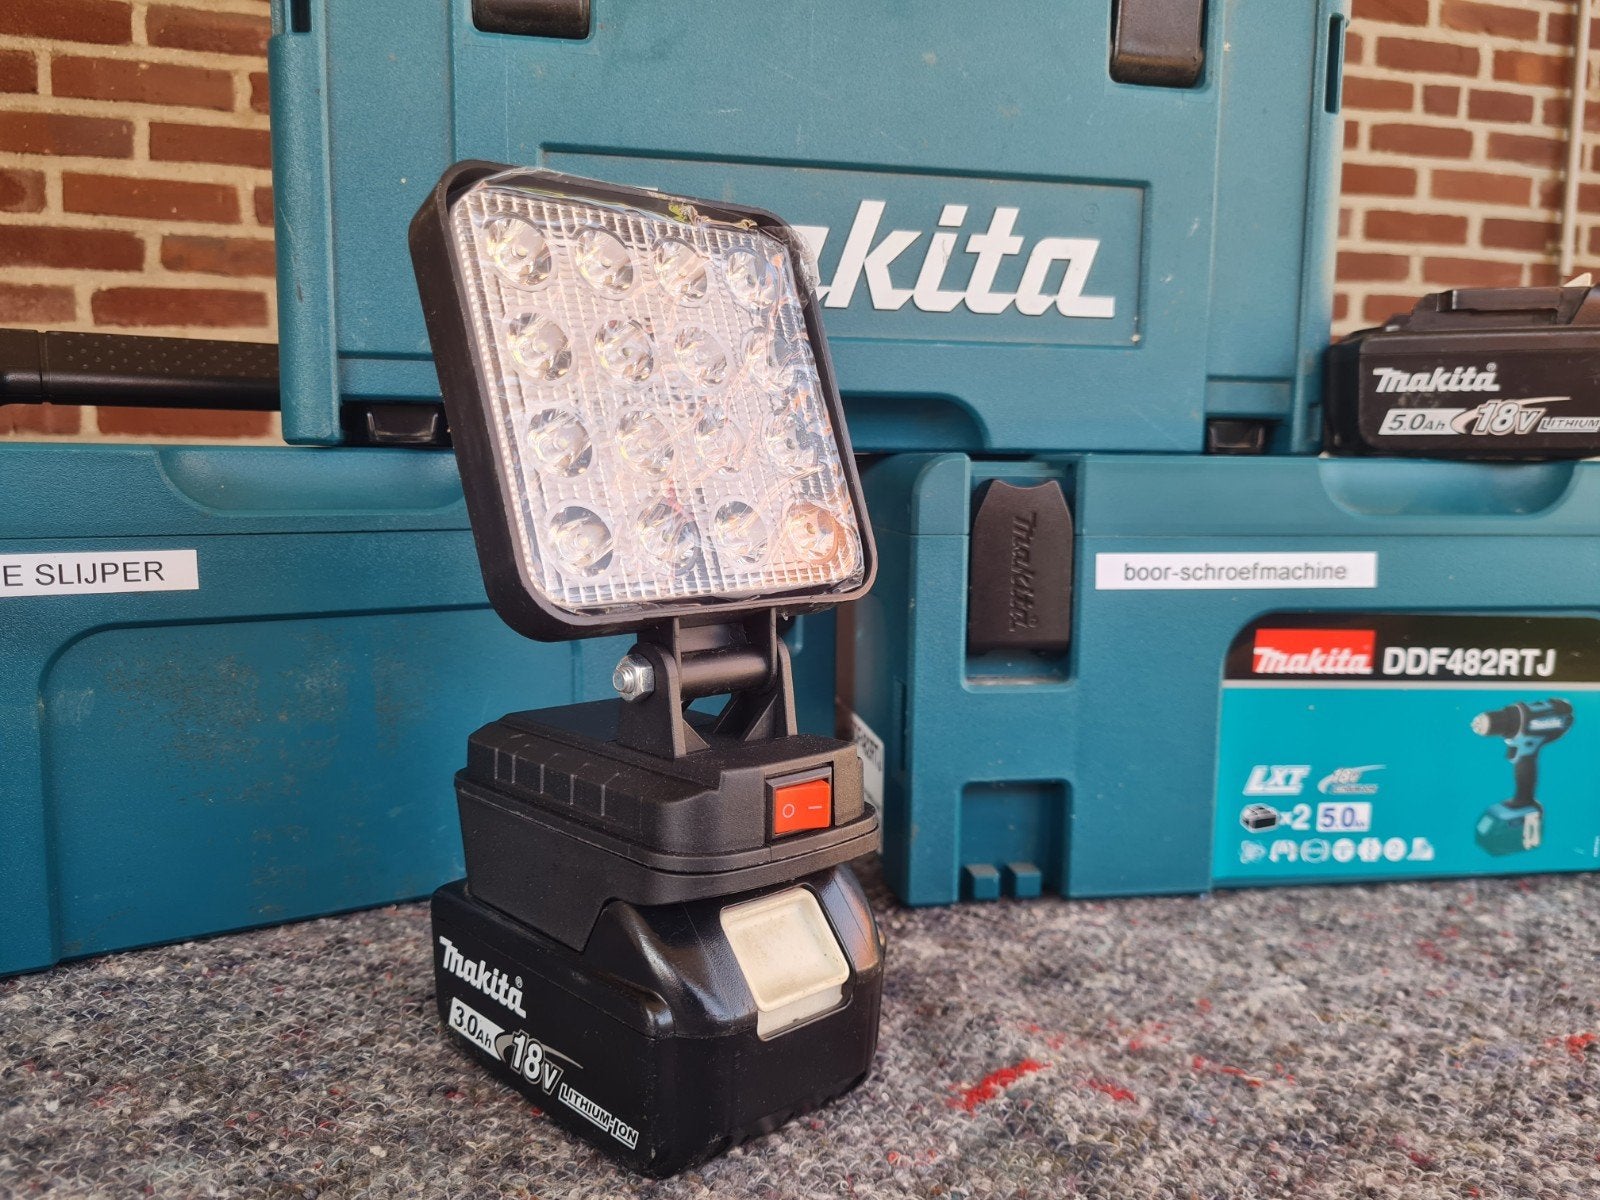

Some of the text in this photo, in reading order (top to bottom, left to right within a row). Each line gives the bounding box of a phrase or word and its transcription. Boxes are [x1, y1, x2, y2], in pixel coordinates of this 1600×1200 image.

[792, 199, 1116, 318] kita
[1373, 365, 1500, 393] Makita
[1387, 413, 1446, 432] 5.0Ah
[1473, 400, 1543, 436] 18V
[35, 561, 165, 586] SLIJPER
[1009, 511, 1037, 632] Makita
[1123, 562, 1348, 582] boor-schroefmachine
[1253, 646, 1557, 676] Makita DDF482RTJ
[1243, 765, 1311, 796] LXT
[439, 935, 527, 1019] Makita
[453, 1004, 640, 1150] 3.0Ah 18V LITHIUM-ION
